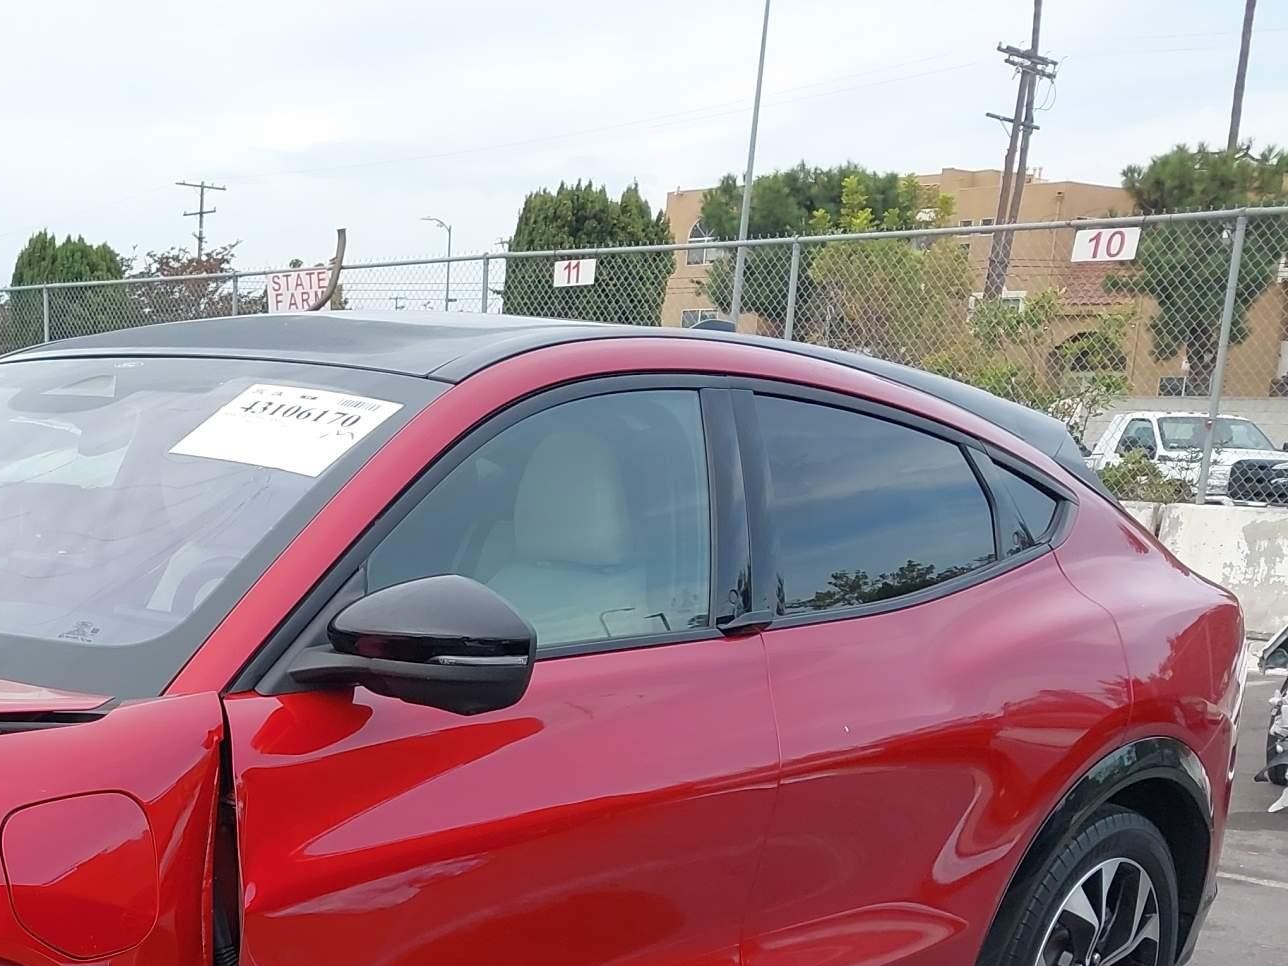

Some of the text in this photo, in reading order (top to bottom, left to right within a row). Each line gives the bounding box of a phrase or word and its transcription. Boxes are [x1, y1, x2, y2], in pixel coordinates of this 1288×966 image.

[1088, 230, 1126, 259] 10
[272, 271, 327, 292] STATE
[563, 261, 581, 285] 11
[240, 400, 362, 428] 43106170
